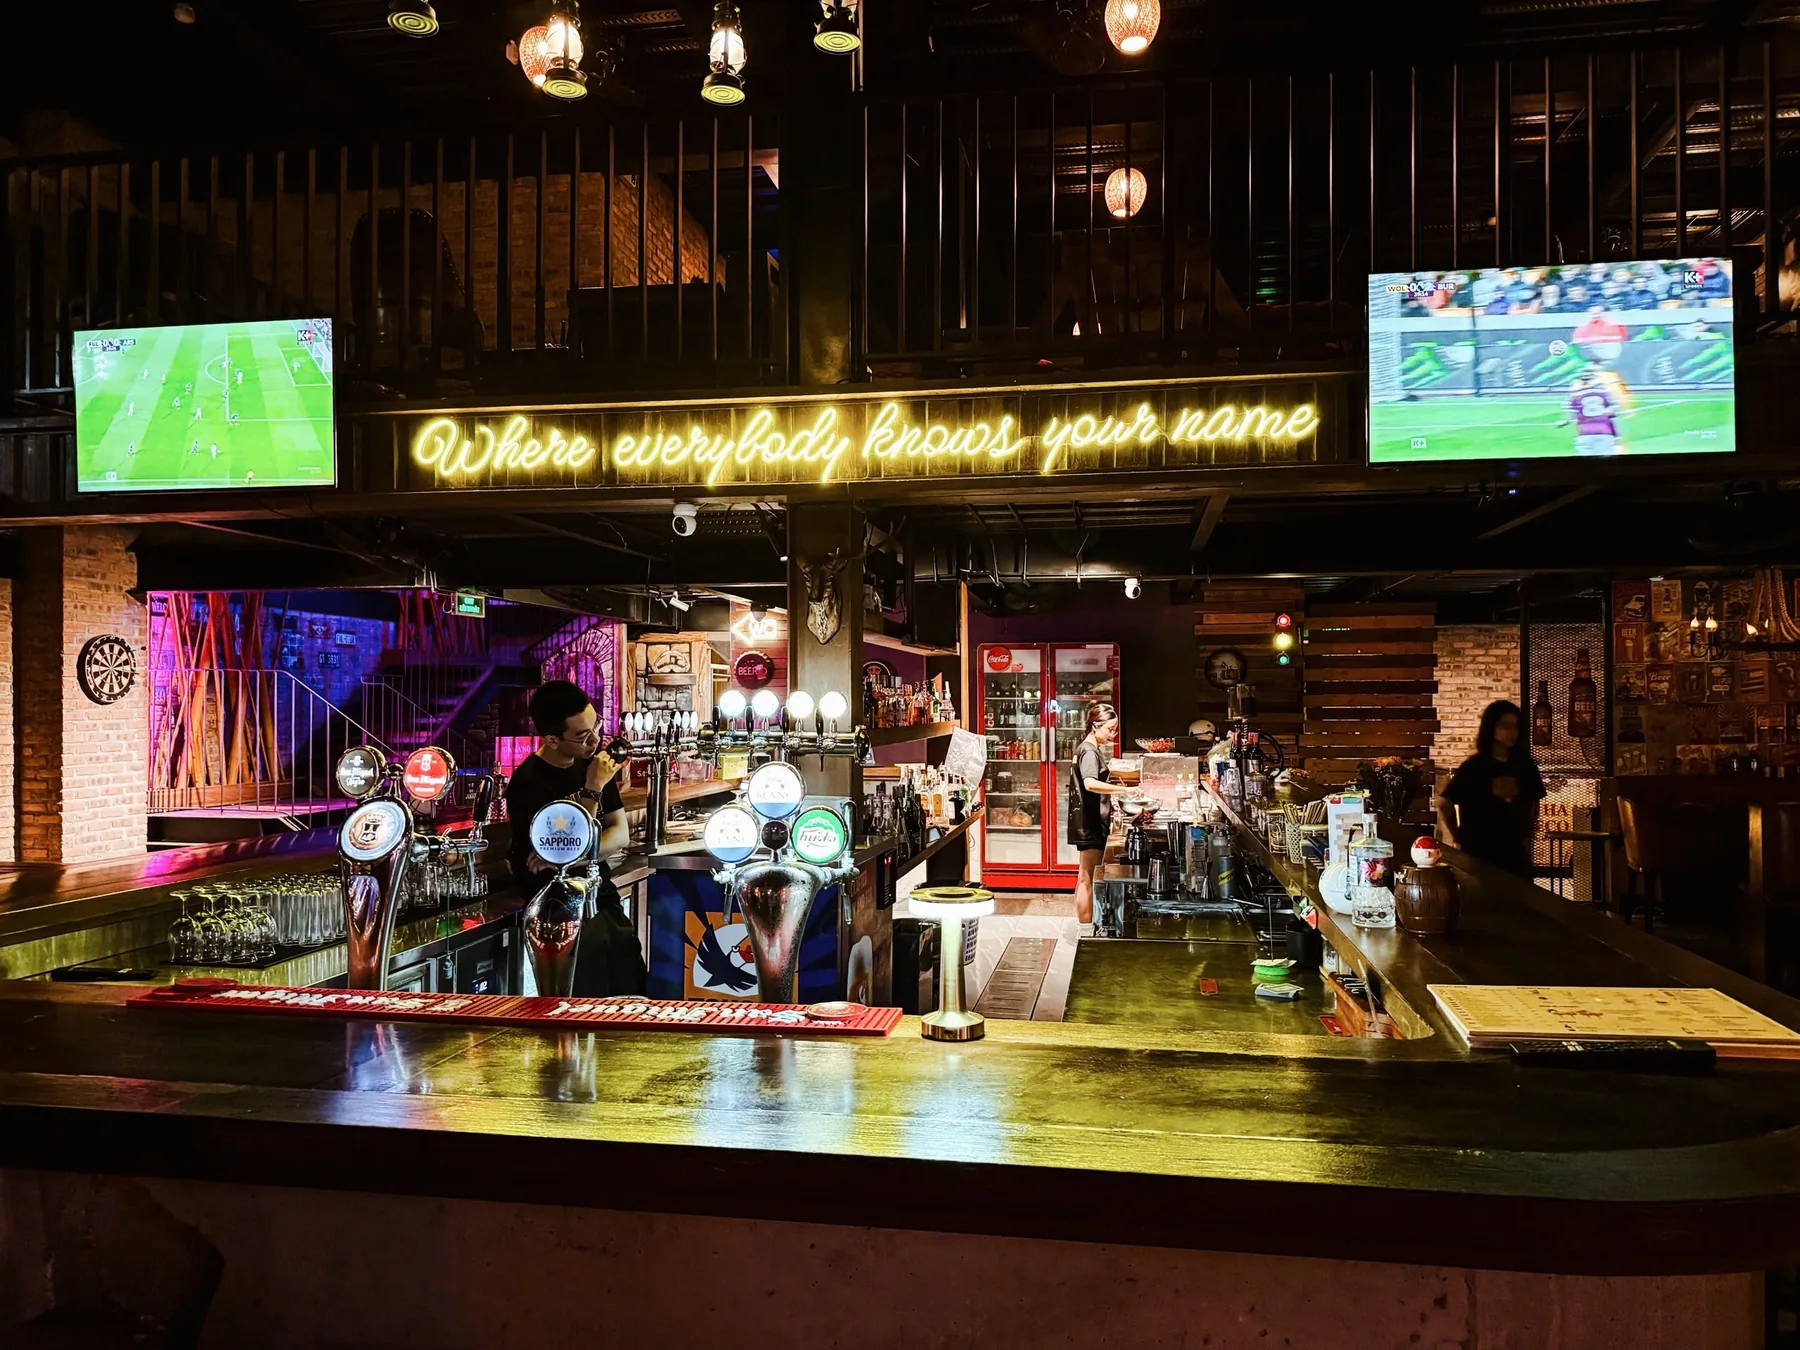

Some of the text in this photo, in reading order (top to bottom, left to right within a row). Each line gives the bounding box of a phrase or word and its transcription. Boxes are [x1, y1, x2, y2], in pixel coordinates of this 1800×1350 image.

[1437, 282, 1455, 290] BUR
[412, 402, 1320, 486] Where everybody knows your name
[988, 654, 1010, 664] Coca-Cola
[1574, 701, 1596, 712] BEER
[539, 836, 582, 848] SAPPORO
[545, 1001, 806, 1024] San Miguel
